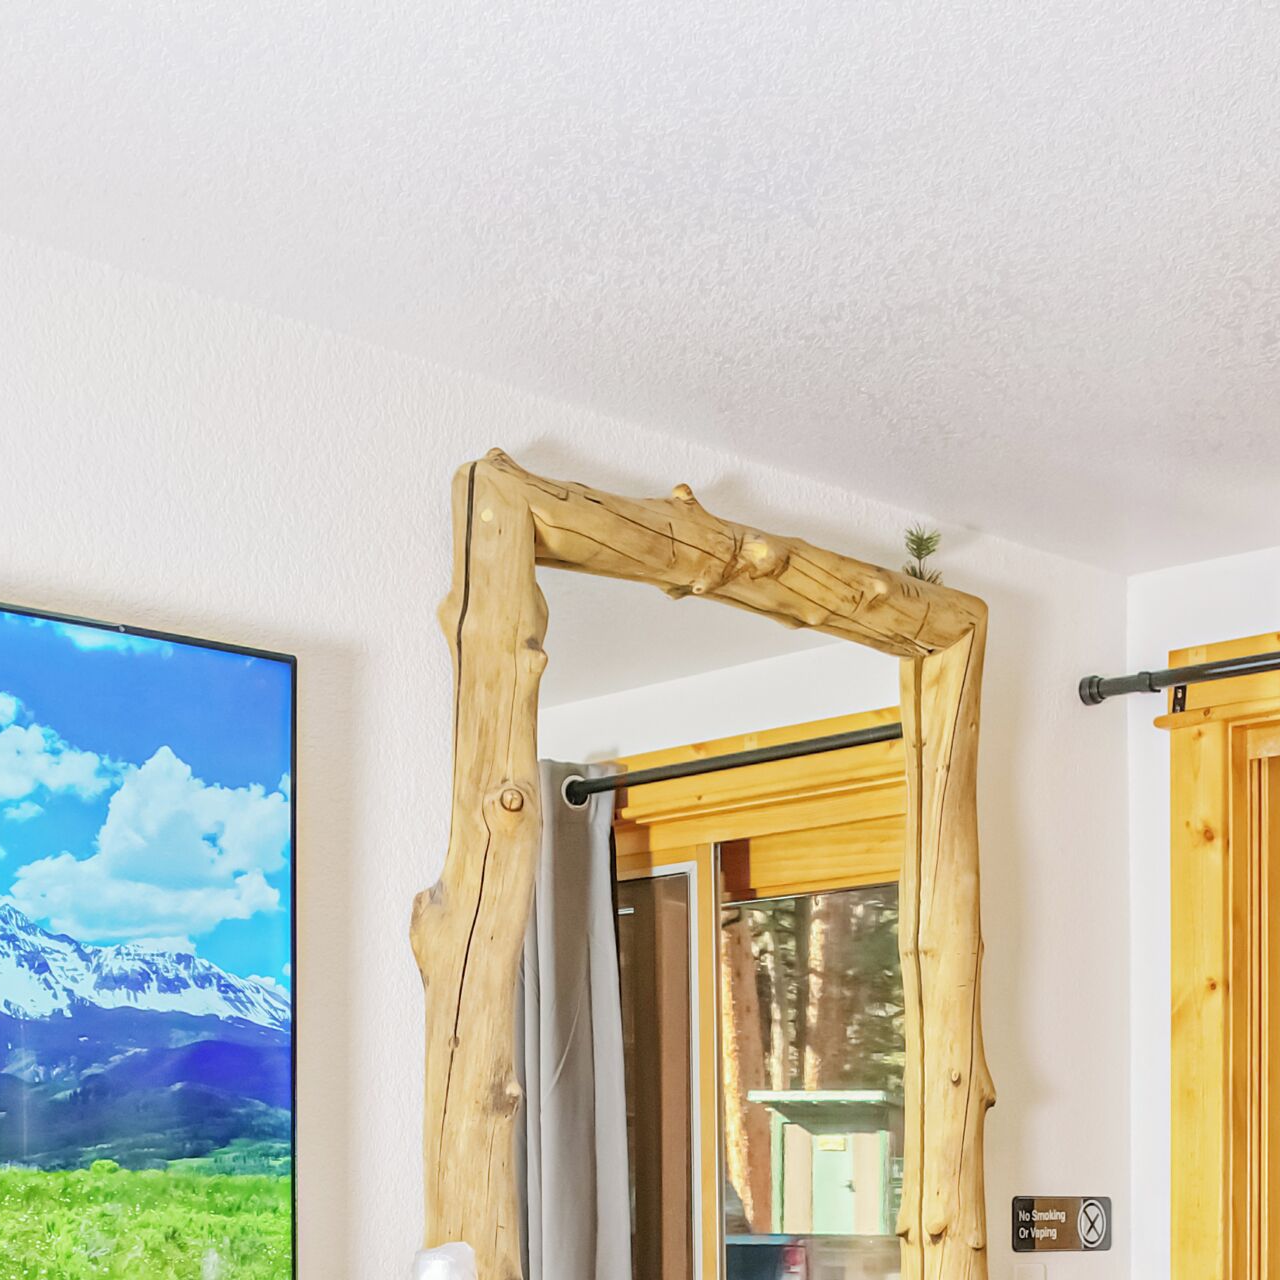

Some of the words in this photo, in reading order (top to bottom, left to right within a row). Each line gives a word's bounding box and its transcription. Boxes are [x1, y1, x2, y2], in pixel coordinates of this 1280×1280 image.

[1019, 1210, 1030, 1222] No
[1031, 1209, 1066, 1223] Smoking
[1019, 1227, 1029, 1239] Or
[1030, 1227, 1057, 1240] Vaping
